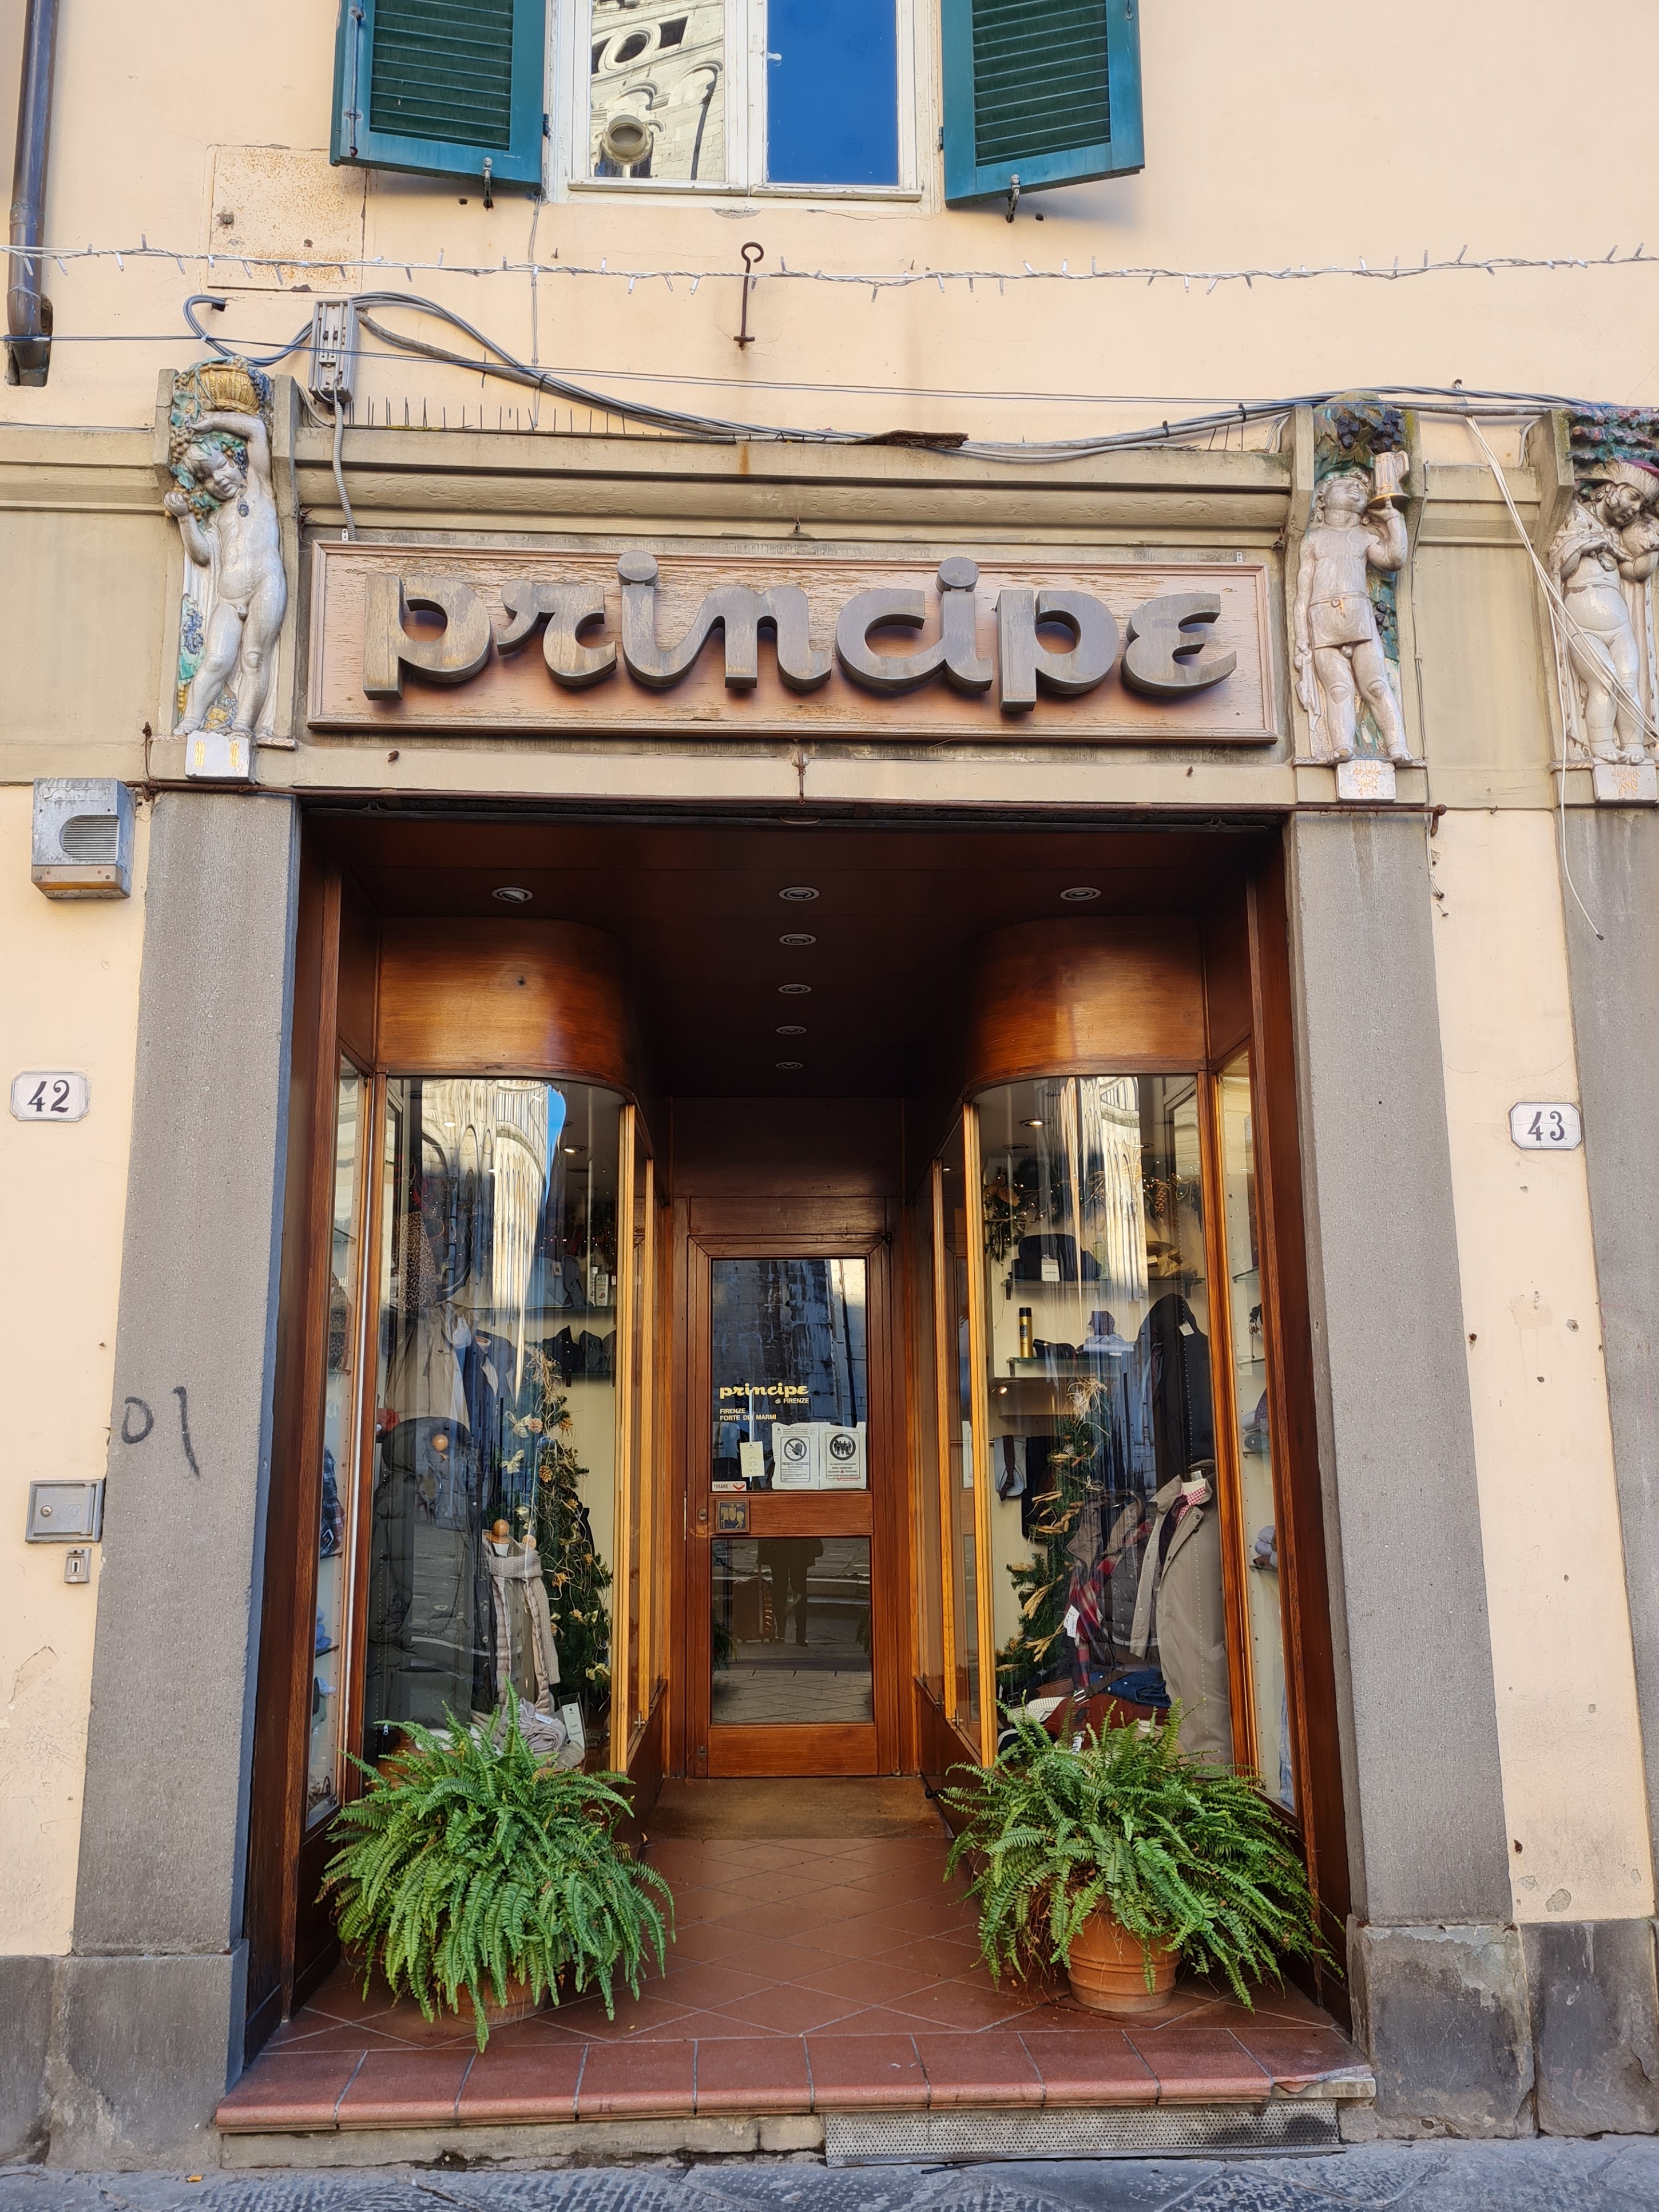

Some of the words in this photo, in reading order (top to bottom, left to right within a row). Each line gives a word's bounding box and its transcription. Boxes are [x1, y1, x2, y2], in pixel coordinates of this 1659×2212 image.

[365, 551, 1237, 712] principe
[27, 1079, 70, 1112] 42
[1528, 1111, 1565, 1141] 43
[720, 1382, 809, 1399] principe
